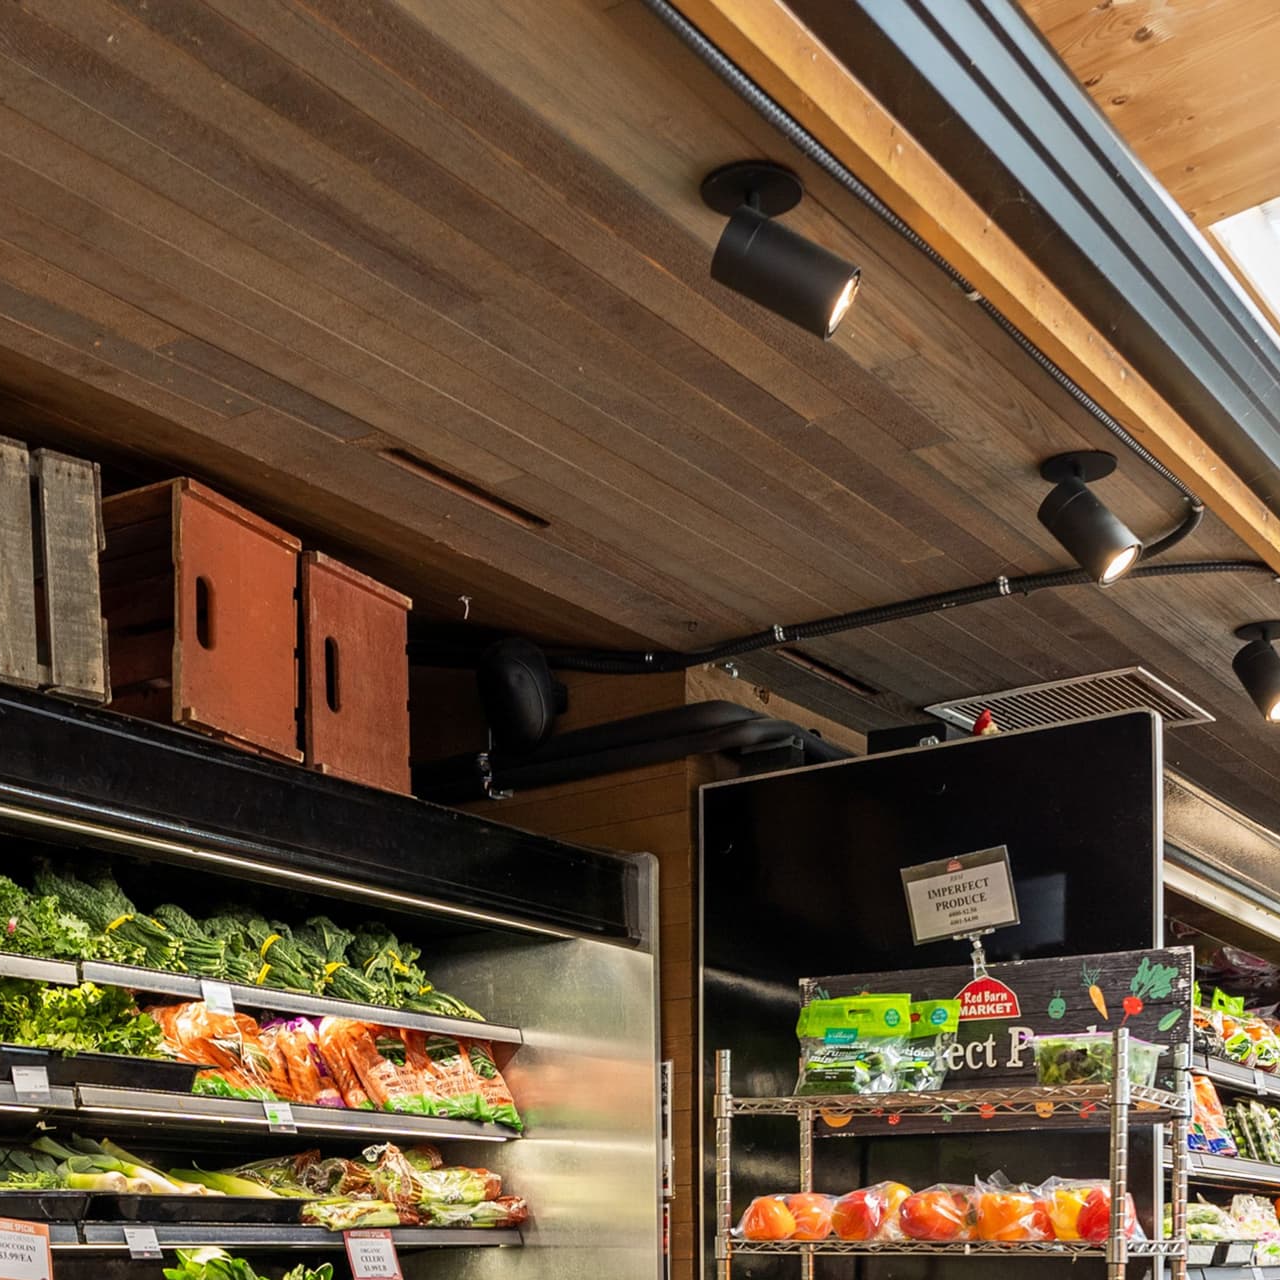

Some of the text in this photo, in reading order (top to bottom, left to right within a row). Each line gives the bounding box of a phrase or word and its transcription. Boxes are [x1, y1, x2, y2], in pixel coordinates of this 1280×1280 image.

[927, 877, 989, 899] IMPERFECT
[935, 892, 988, 911] PRODUCE
[964, 990, 1008, 1004] Red Barn
[959, 1002, 1013, 1017] MARKET
